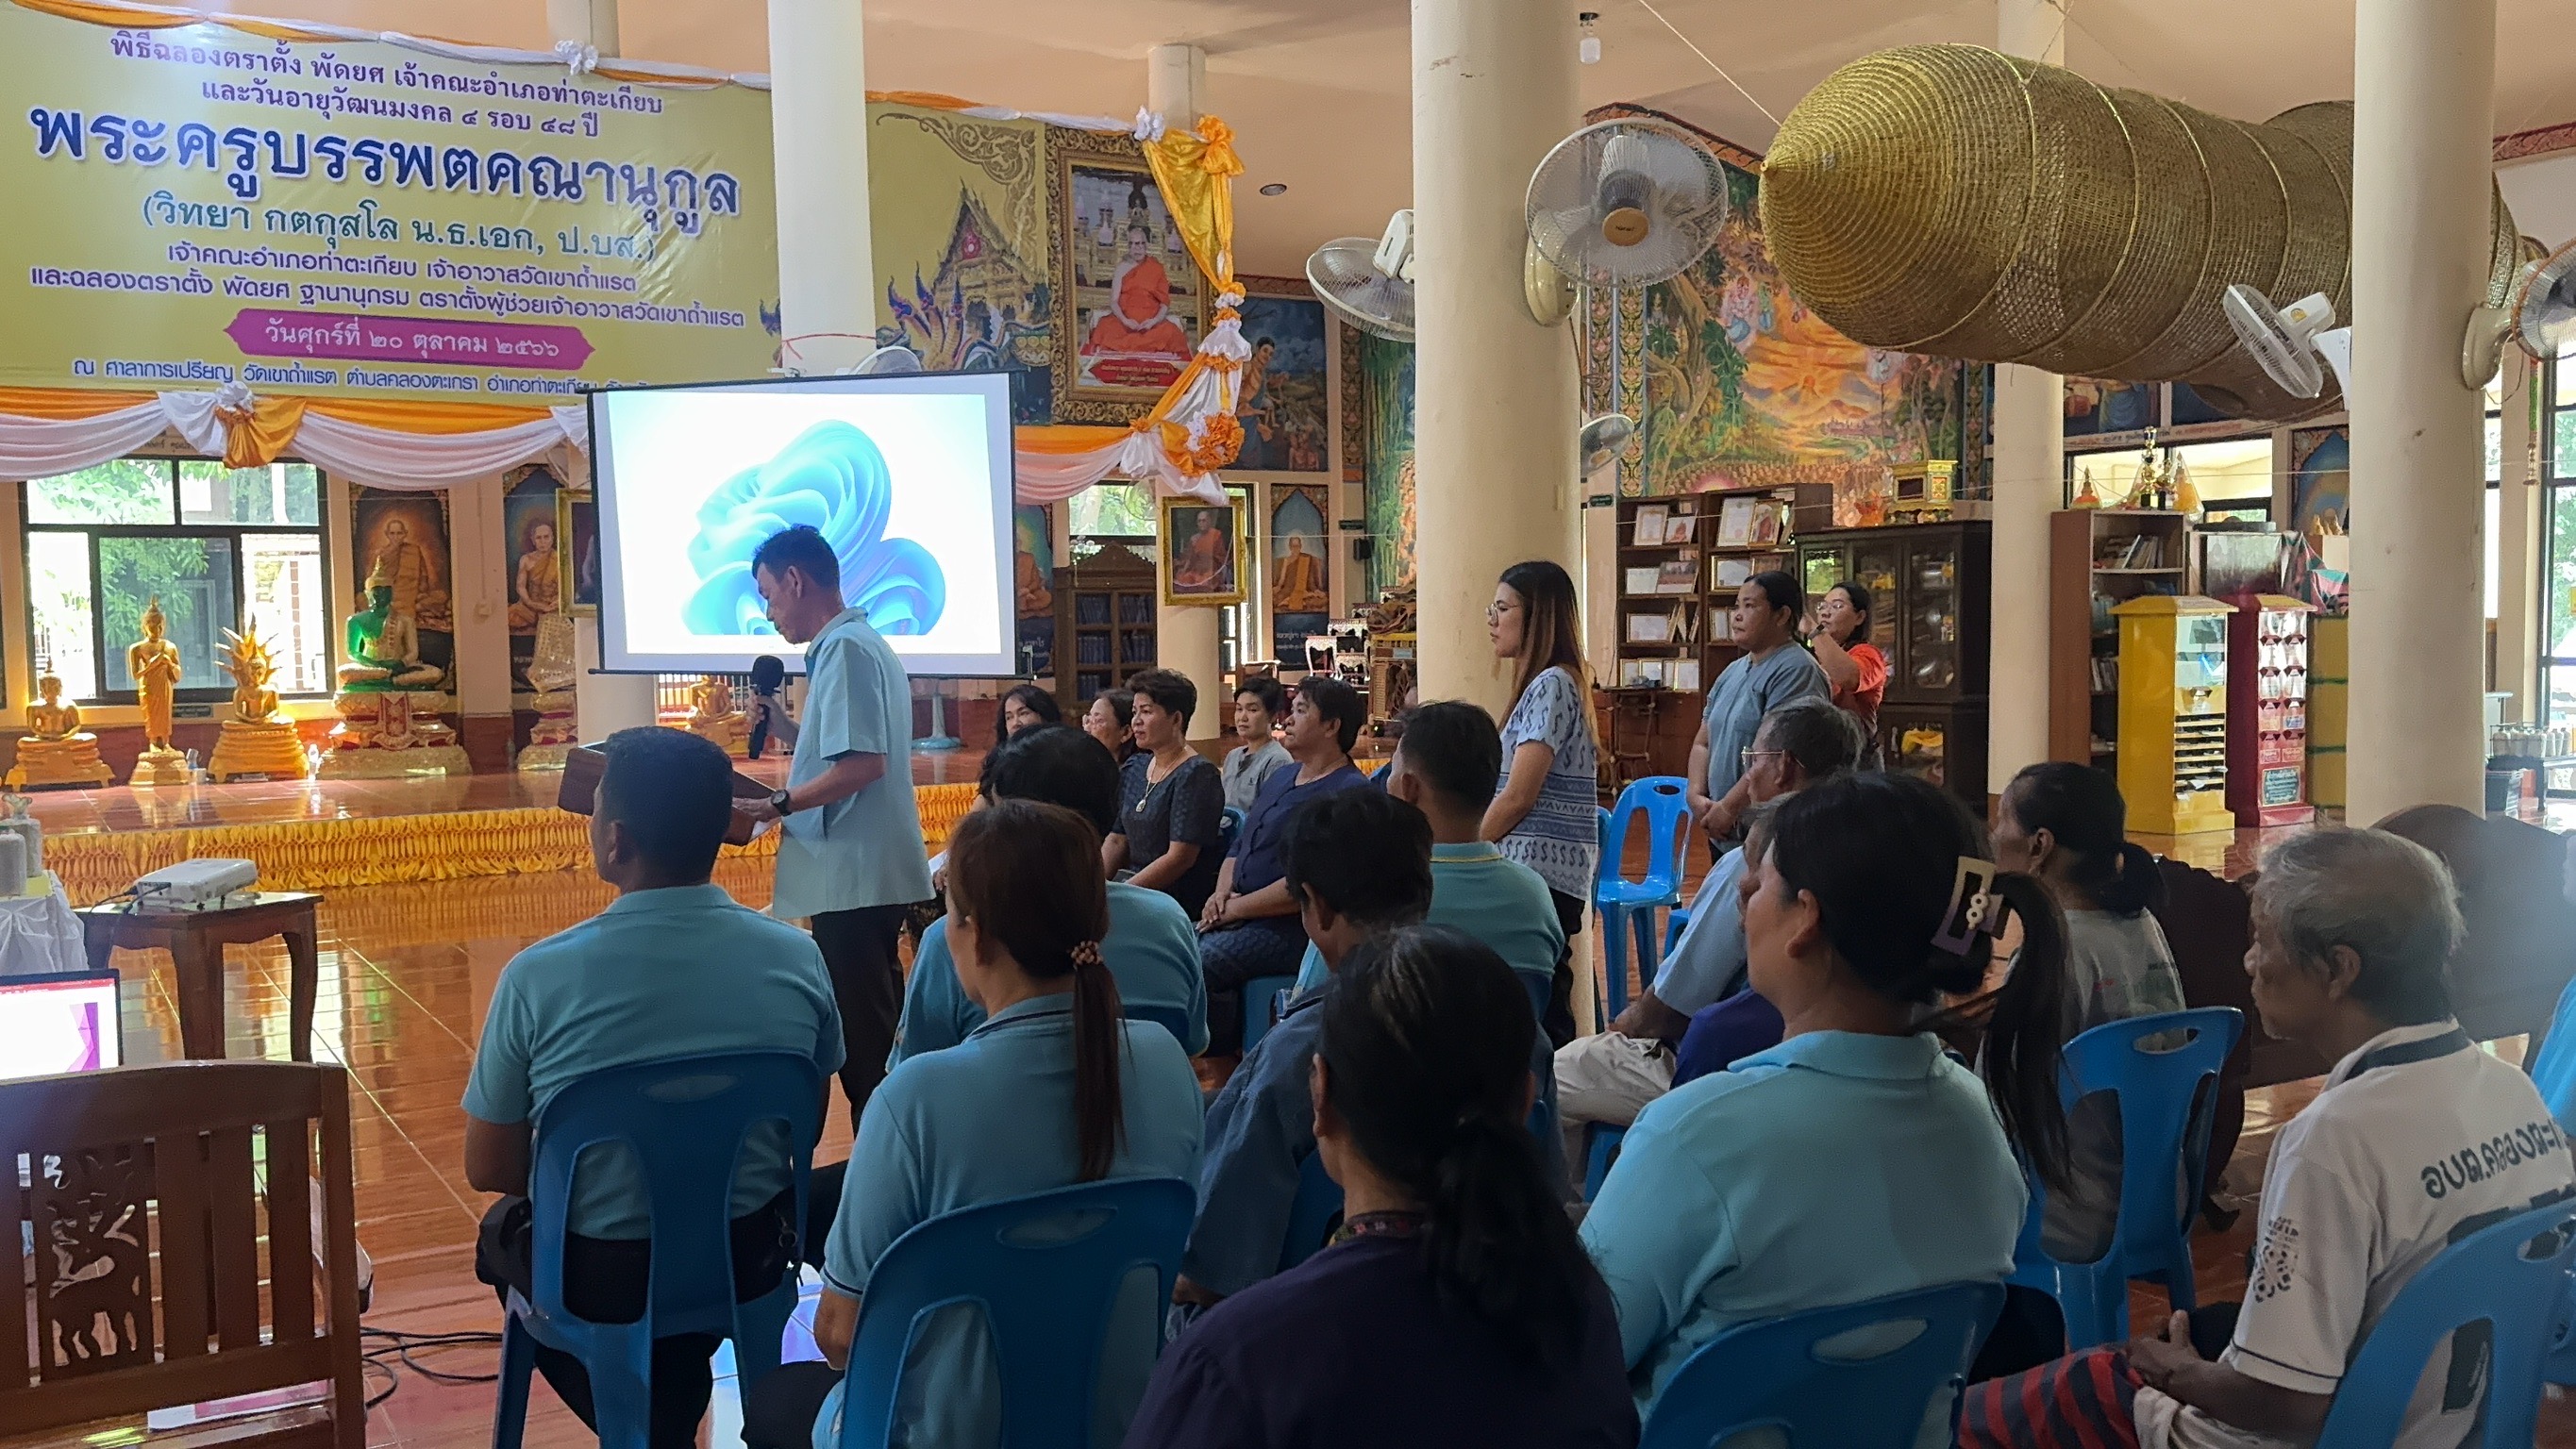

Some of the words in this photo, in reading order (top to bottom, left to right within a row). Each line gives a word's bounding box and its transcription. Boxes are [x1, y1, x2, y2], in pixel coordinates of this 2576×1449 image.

[110, 29, 302, 75] พิธีฉลองตราตั้ง
[310, 51, 384, 84] พัดยศ
[394, 61, 663, 114] เจ้าคณะอำเภอท่าตะเกียบ
[202, 77, 452, 124] และวันอายุวัฒนมงคล
[488, 109, 531, 131] รอบ
[582, 110, 599, 138] ปี
[30, 108, 739, 234] พระครูบรรพตคณานุกูล
[143, 190, 250, 230] (วิทยา
[265, 200, 399, 249] กตกุสโล
[169, 241, 417, 278] เจ้าคณะอำเภอท่าตะเกียบ
[427, 258, 637, 292] เจ้าอาวาสวัดเขาถ้ำแรต
[31, 267, 213, 295] และฉลองตราตั้ง
[223, 275, 290, 299] พัดยศ
[299, 282, 410, 308] ฐานานุกรม
[419, 286, 744, 327] ตราตั้งผู้ช่วยเจ้าอาวาสวัดเขาถ้ำแรต
[265, 316, 361, 354] วันศุกร์ที่
[412, 333, 488, 358] ตุลาคม
[74, 359, 94, 375] ณ
[106, 359, 233, 383] ศาลาการเปรียญ
[243, 361, 338, 385] วัดเขาถ้ำแรต
